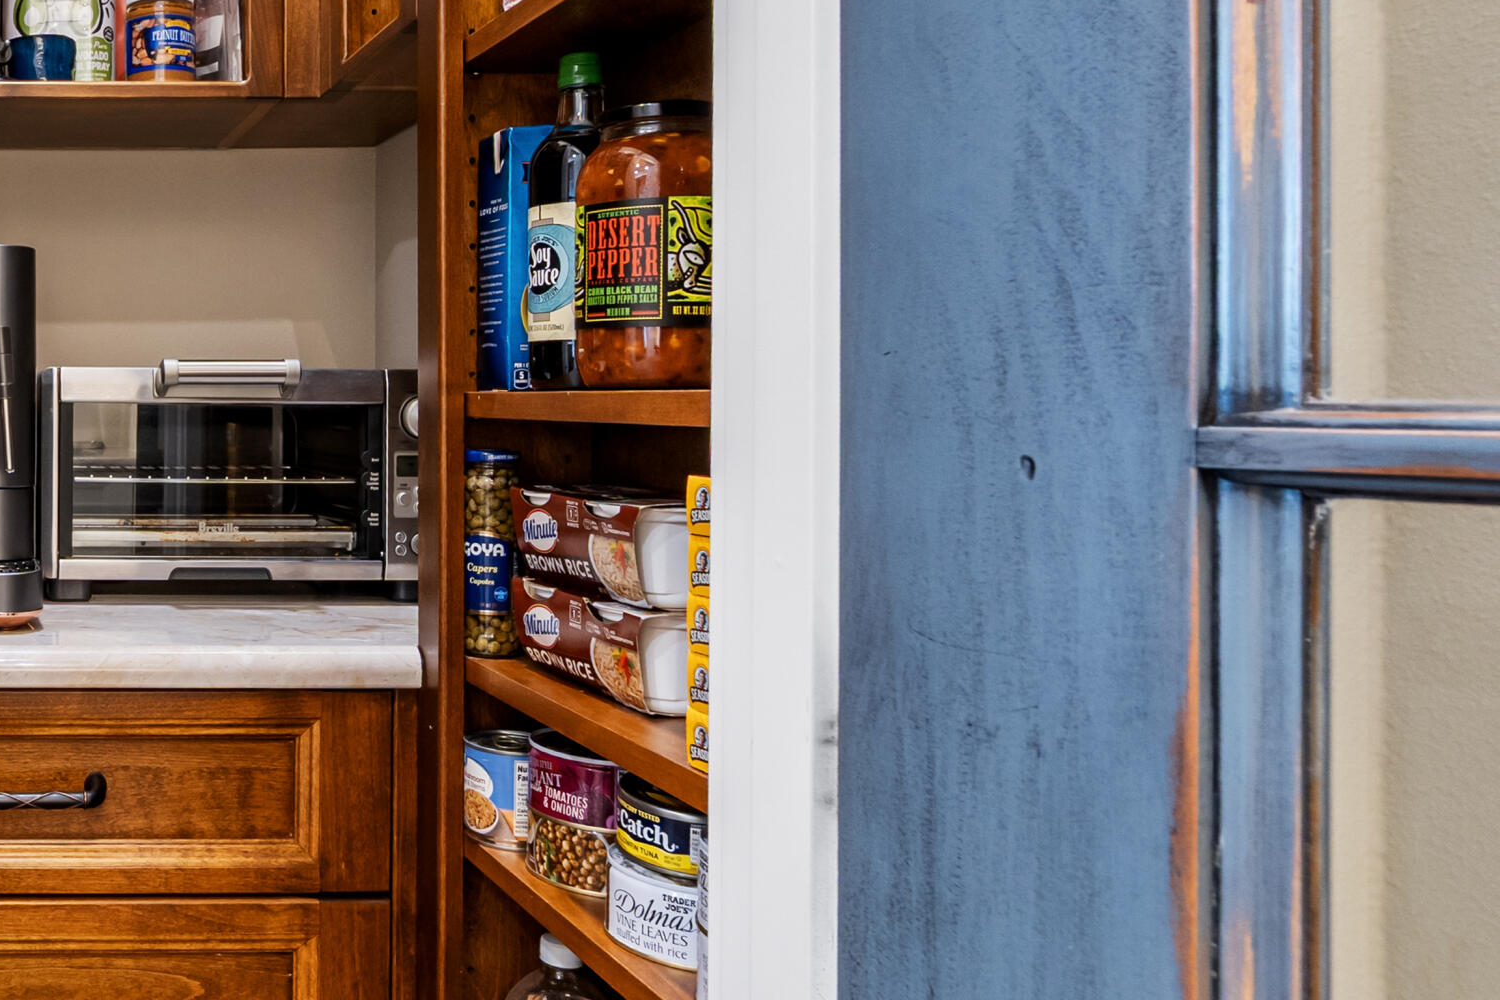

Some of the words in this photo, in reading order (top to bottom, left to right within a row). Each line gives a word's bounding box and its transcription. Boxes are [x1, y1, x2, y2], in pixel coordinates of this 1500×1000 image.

[152, 29, 179, 41] PEANUT
[597, 209, 640, 219] AUTHENTIC
[588, 215, 660, 250] DESERT
[531, 243, 551, 269] Soy
[588, 246, 659, 281] PEPPER
[528, 264, 559, 289] Sauce
[588, 286, 605, 297] CORN
[606, 286, 632, 295] BLACK
[634, 284, 658, 294] BEAN
[617, 294, 638, 304] PEPPER
[523, 518, 558, 541] Minute
[467, 561, 498, 575] Capers
[524, 554, 566, 575] BROWN
[564, 558, 593, 579] RICE
[523, 612, 560, 636] Minute
[525, 646, 567, 672] BROWN
[564, 657, 595, 681] RICE
[543, 796, 549, 808] &
[550, 800, 585, 821] ONIONS
[545, 784, 589, 809] TOMATOES
[638, 808, 661, 824] TESTED
[620, 808, 676, 853] Catch
[640, 846, 659, 860] TUNA
[613, 888, 697, 933] Dolmas
[662, 893, 697, 908] TRADER
[665, 903, 689, 915] JOE'S
[616, 911, 638, 933] VINE
[641, 923, 689, 947] LEAVES
[616, 927, 641, 947] stuffed
[643, 939, 664, 954] with
[667, 946, 688, 961] rice
